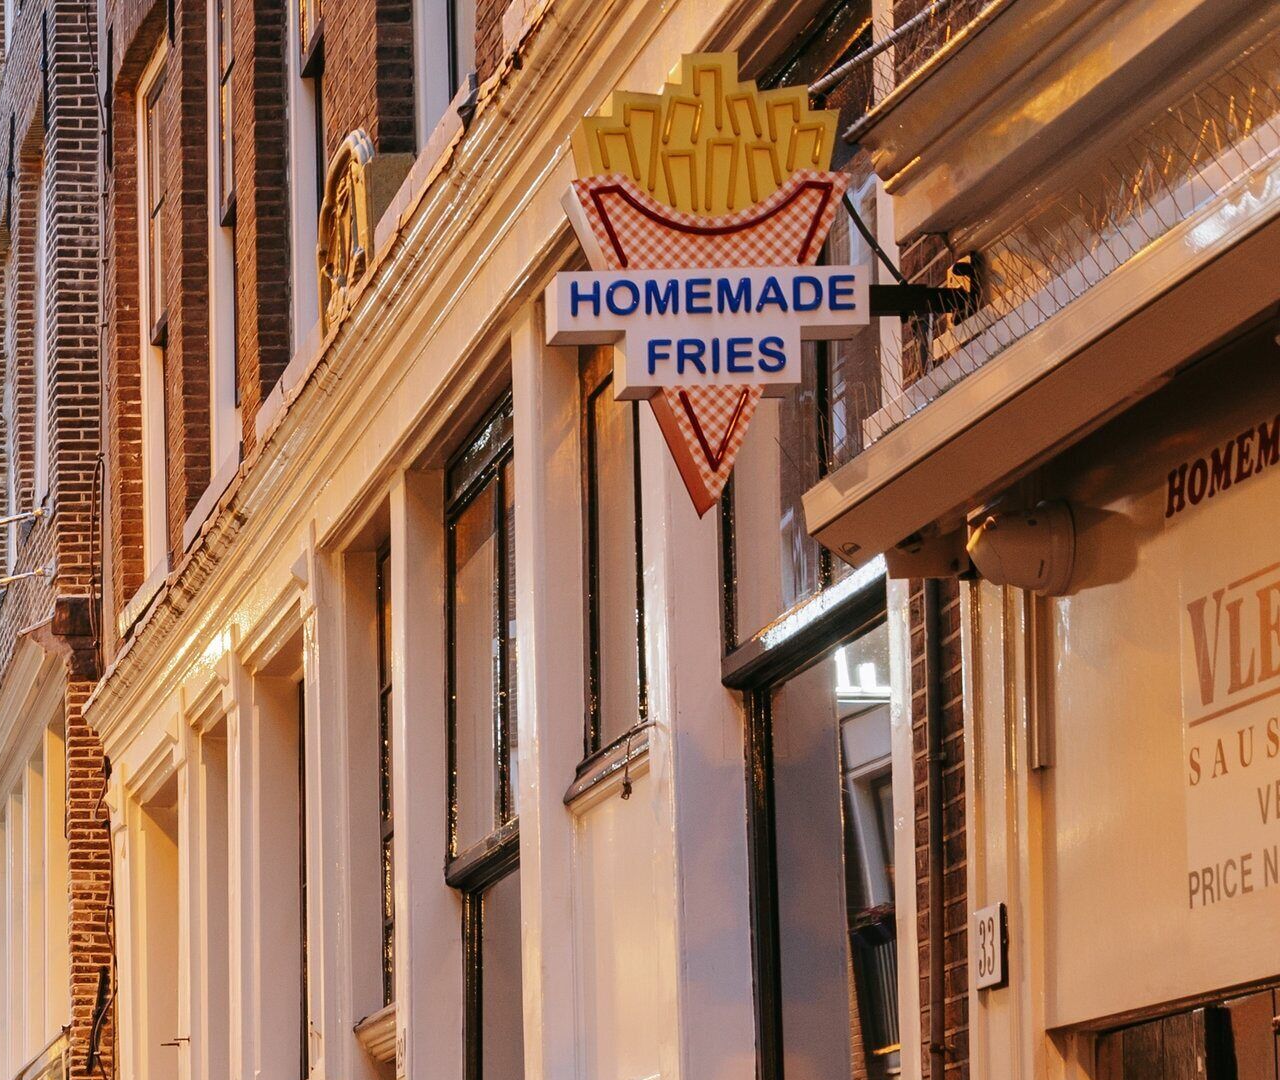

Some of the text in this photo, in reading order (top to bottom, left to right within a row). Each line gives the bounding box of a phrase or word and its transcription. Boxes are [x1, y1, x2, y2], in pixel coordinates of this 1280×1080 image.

[570, 275, 856, 317] HOMEMADE
[647, 336, 787, 375] FRIES
[1189, 853, 1254, 910] PRICE
[979, 917, 995, 978] 33
